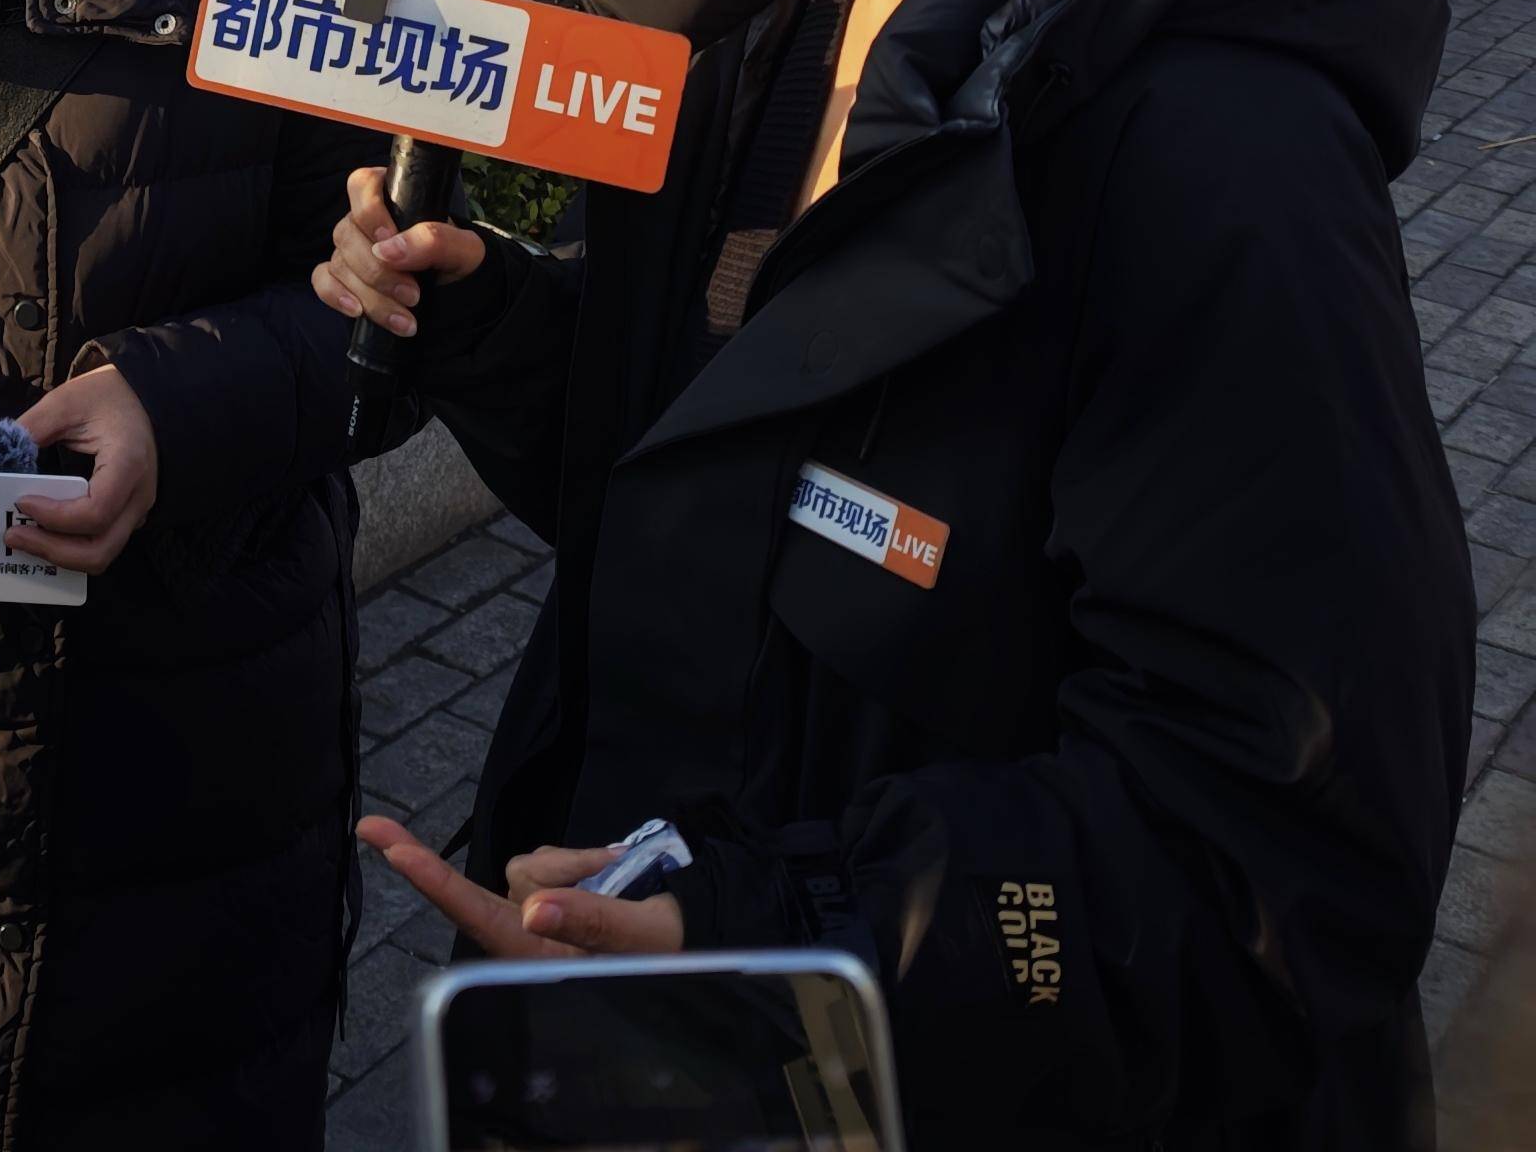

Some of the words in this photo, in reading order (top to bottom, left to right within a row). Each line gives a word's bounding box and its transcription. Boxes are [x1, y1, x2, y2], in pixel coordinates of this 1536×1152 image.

[534, 63, 662, 136] LIVE
[891, 527, 939, 568] LIVE
[1024, 882, 1063, 1004] BLACK
